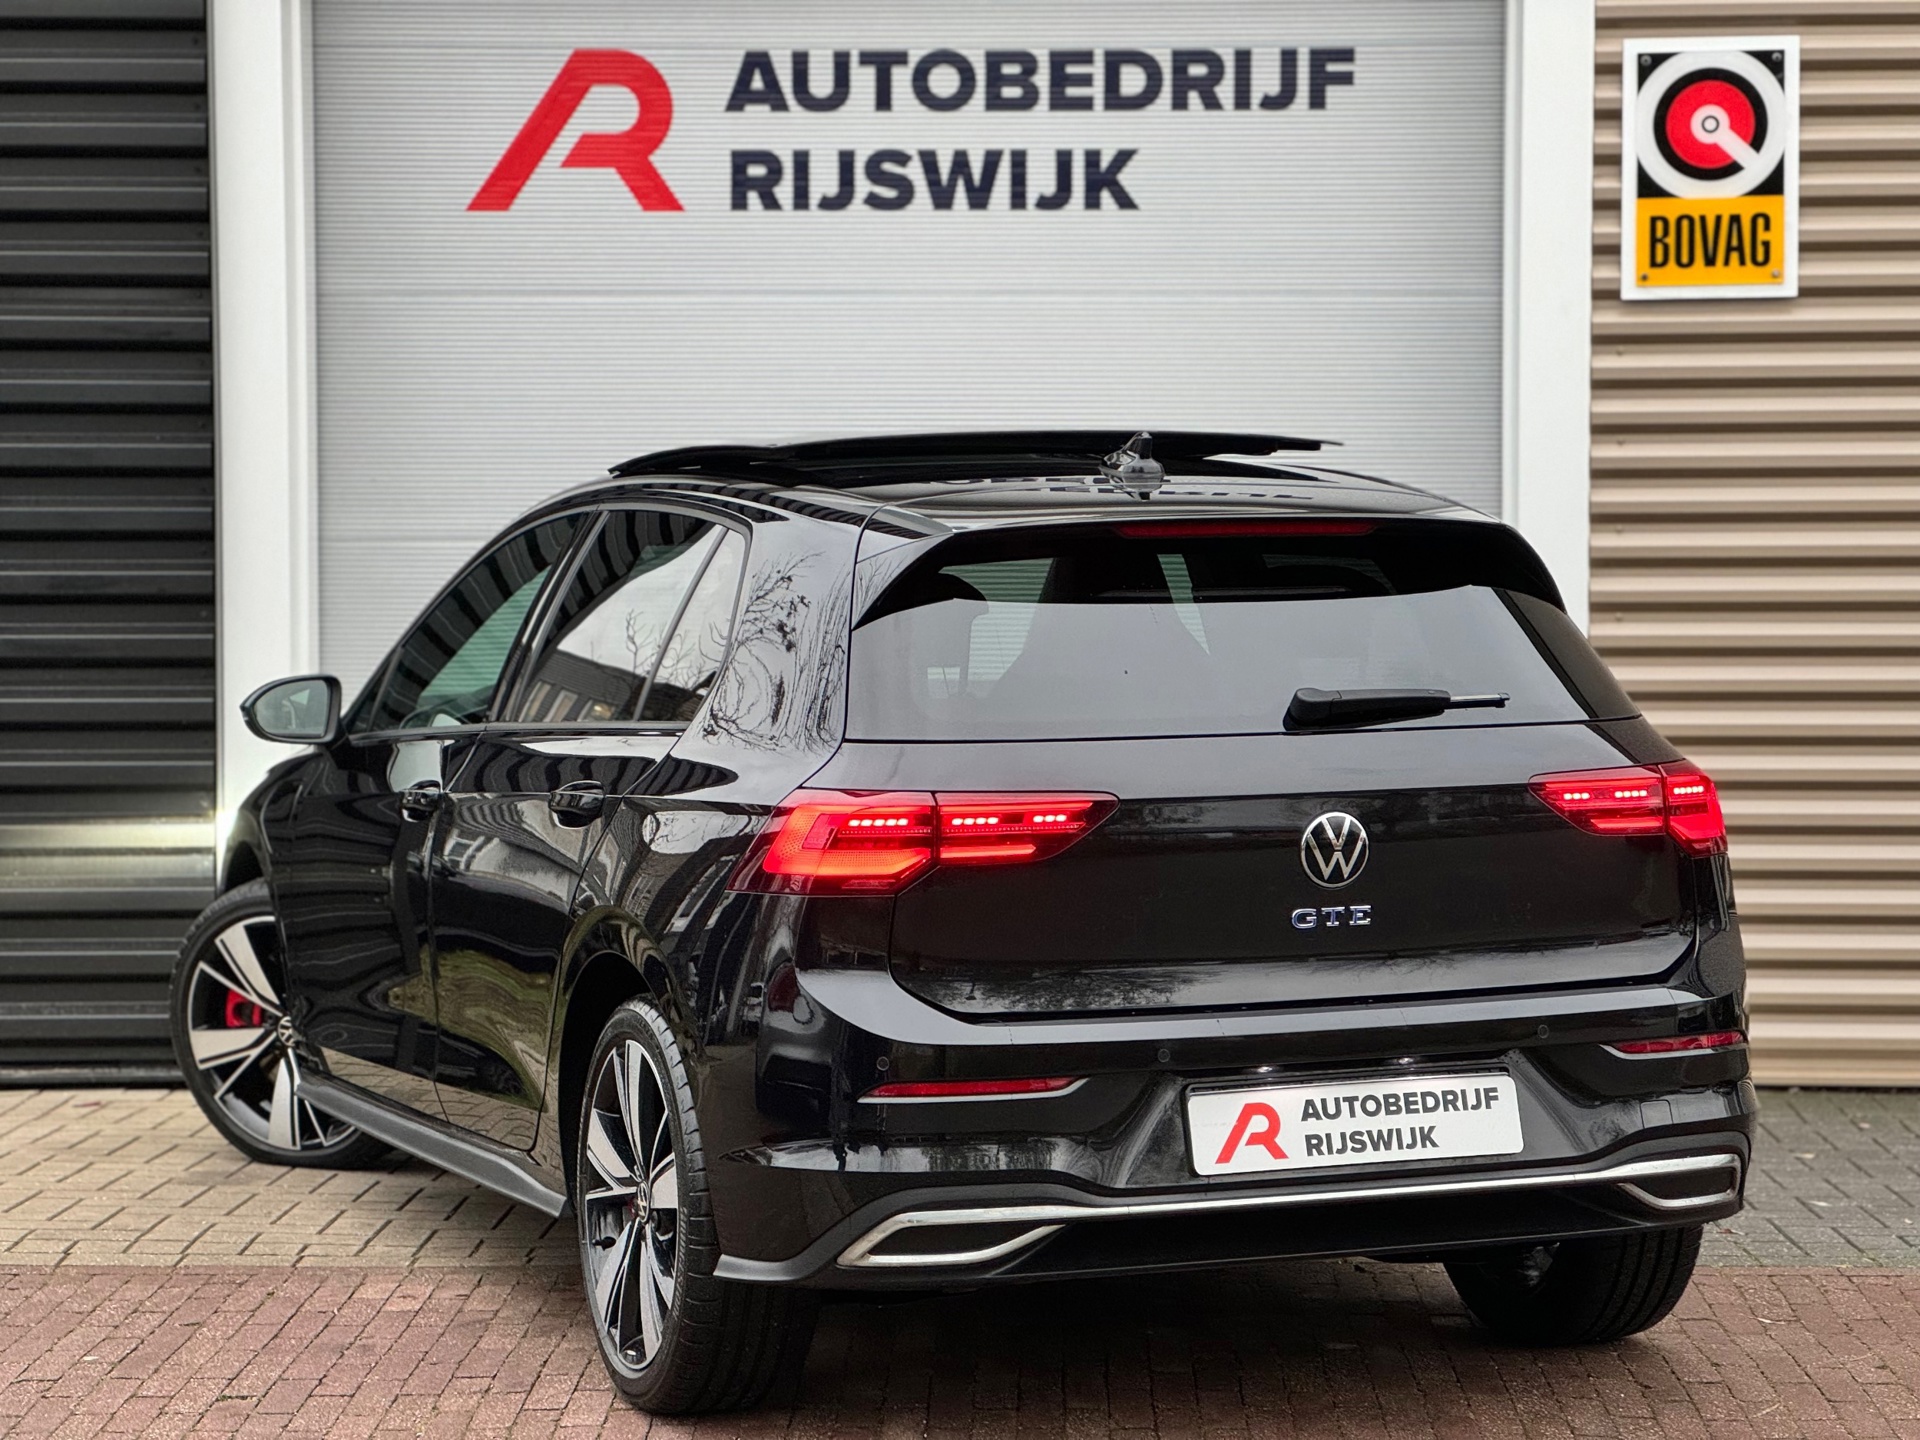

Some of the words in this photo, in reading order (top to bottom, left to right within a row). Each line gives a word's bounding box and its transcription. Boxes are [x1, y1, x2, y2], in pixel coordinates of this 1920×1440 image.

[725, 48, 1355, 113] AUTOBEDRIJF
[730, 149, 1139, 211] RIJSWIJK
[1649, 213, 1771, 269] BOVAG
[1291, 905, 1372, 929] GTE
[1301, 1087, 1500, 1122] AUTOBEDRIJF
[1305, 1126, 1439, 1157] RIJSWIJK
